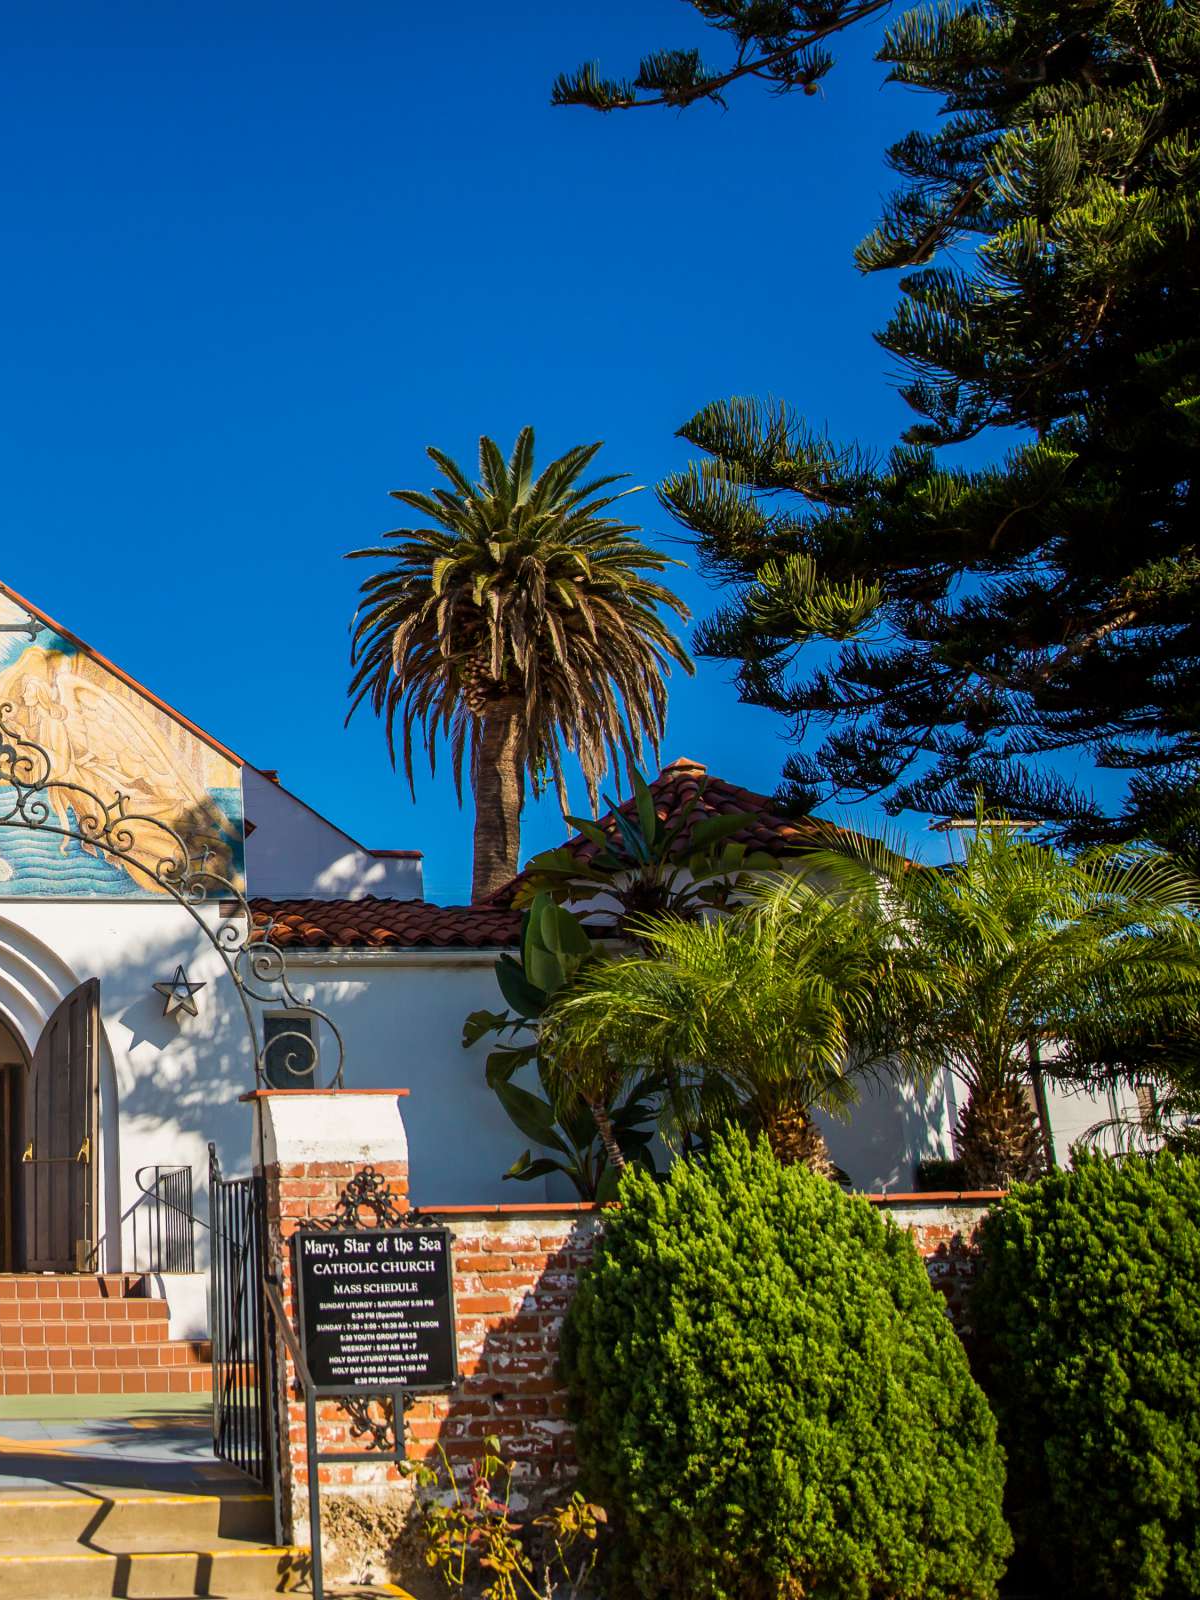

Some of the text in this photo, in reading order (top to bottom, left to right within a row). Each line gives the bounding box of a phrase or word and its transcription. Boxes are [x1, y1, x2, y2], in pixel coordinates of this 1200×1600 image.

[304, 1236, 442, 1258] Mary, Star of the Sea
[314, 1261, 435, 1274] CATHOLIC CHURCH
[334, 1282, 418, 1294] MASS SCHEDULE
[376, 1312, 404, 1320] (Spanish)
[380, 1376, 408, 1384] (Spanish)
